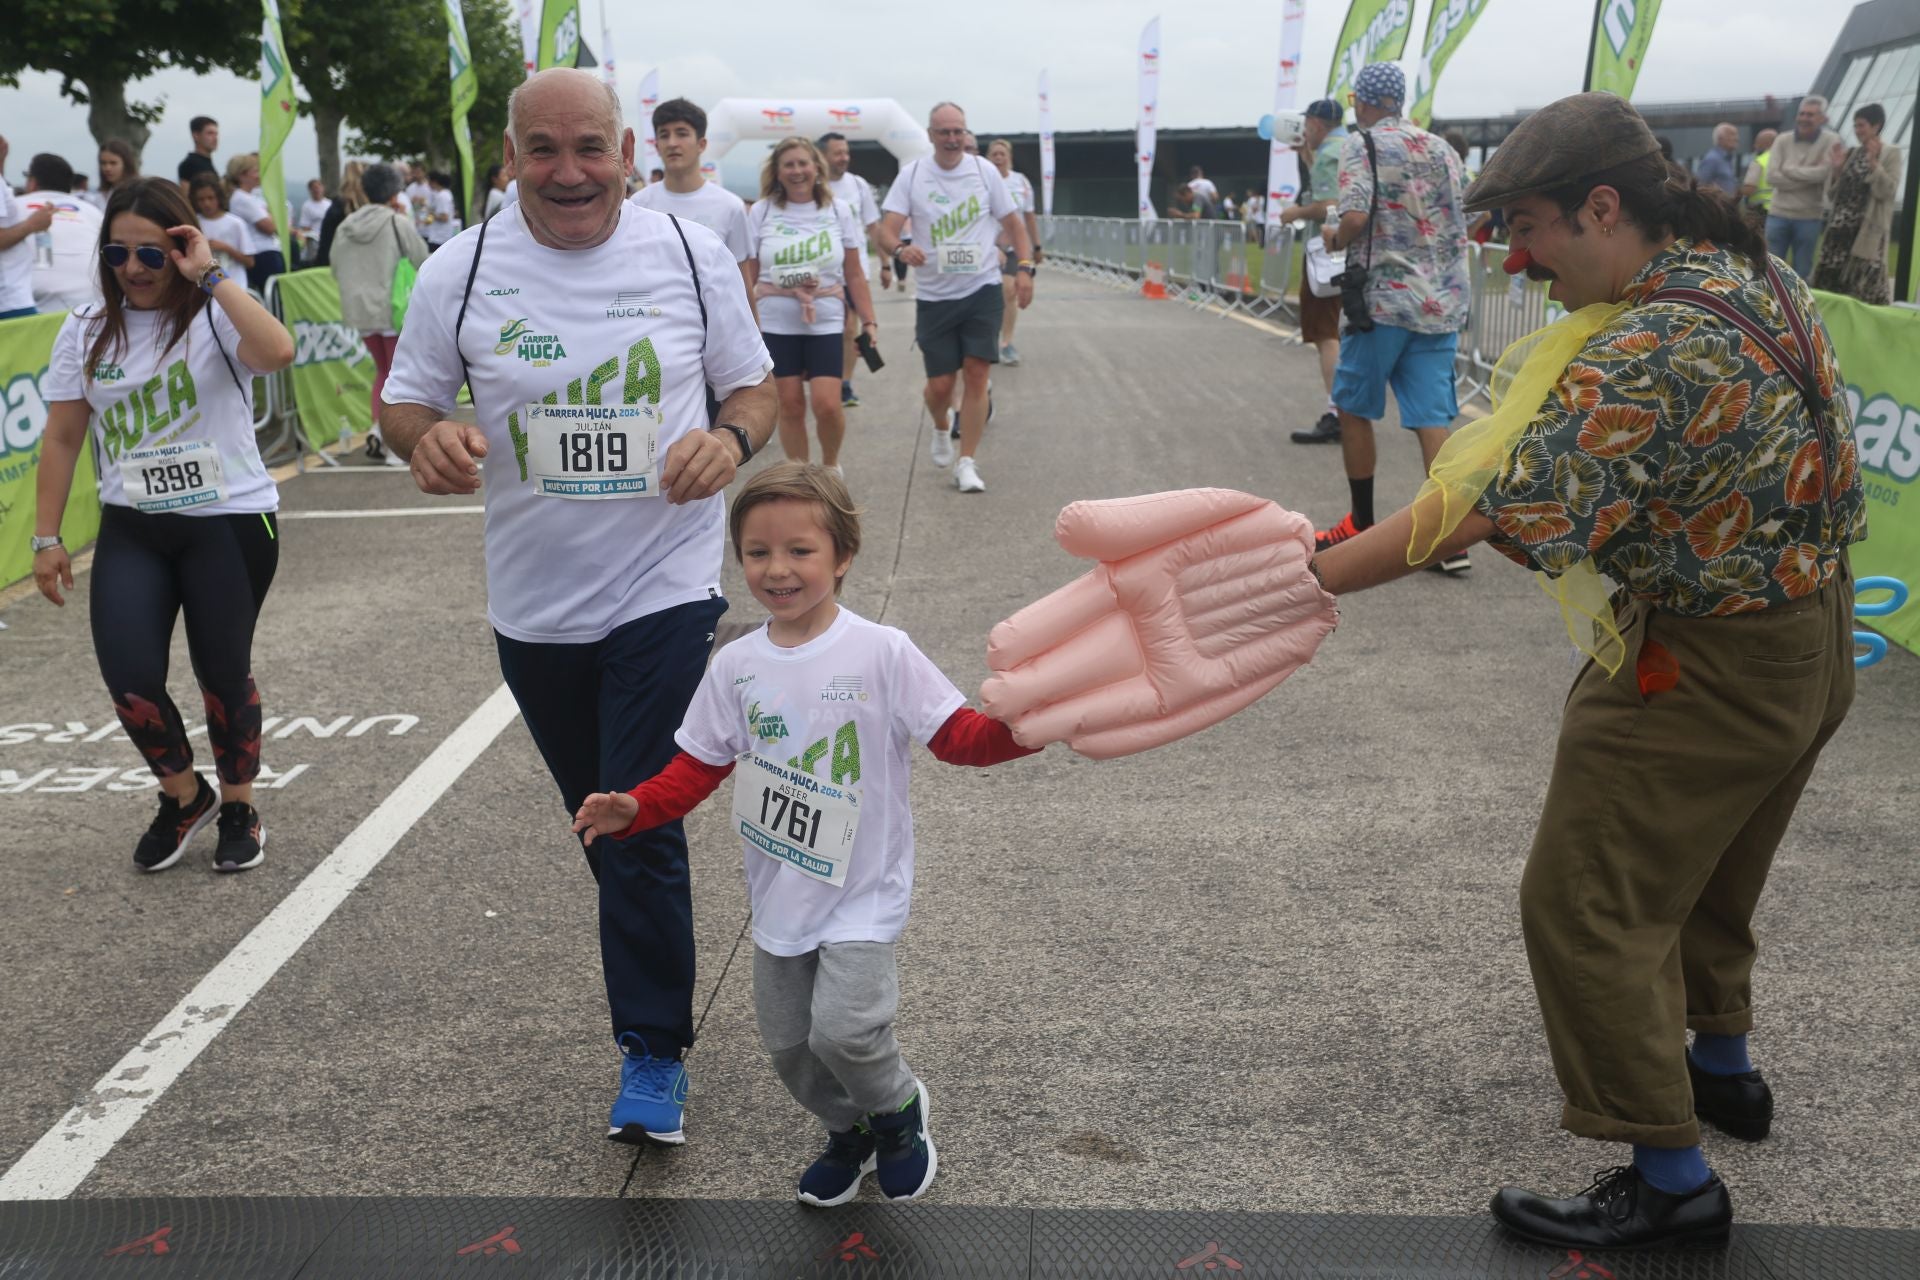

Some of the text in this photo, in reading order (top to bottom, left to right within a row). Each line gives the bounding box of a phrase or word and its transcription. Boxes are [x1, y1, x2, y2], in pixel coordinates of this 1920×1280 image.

[930, 193, 979, 247] HUCA
[774, 230, 832, 265] HUCA
[946, 250, 974, 265] 1305
[606, 307, 644, 318] HUCA
[522, 334, 560, 343] CARRERA
[517, 344, 567, 361] HUCA
[99, 358, 198, 466] HUCA
[545, 407, 640, 420] CARRERA HUCA 2024
[575, 421, 612, 431] JULIÁN
[160, 446, 184, 458] HUCA
[559, 432, 628, 473] 1819
[142, 460, 204, 496] 1398
[582, 483, 601, 493] POR
[603, 482, 614, 491] LA
[617, 480, 644, 490] SALUD
[183, 497, 193, 505] LA
[821, 692, 854, 701] HUCA
[754, 757, 843, 800] CARRERA HUCA 2024
[778, 783, 808, 802] ASIER
[760, 786, 822, 849] 1761
[771, 842, 789, 858] POR
[790, 849, 800, 862] LA
[802, 857, 830, 874] SALUD
